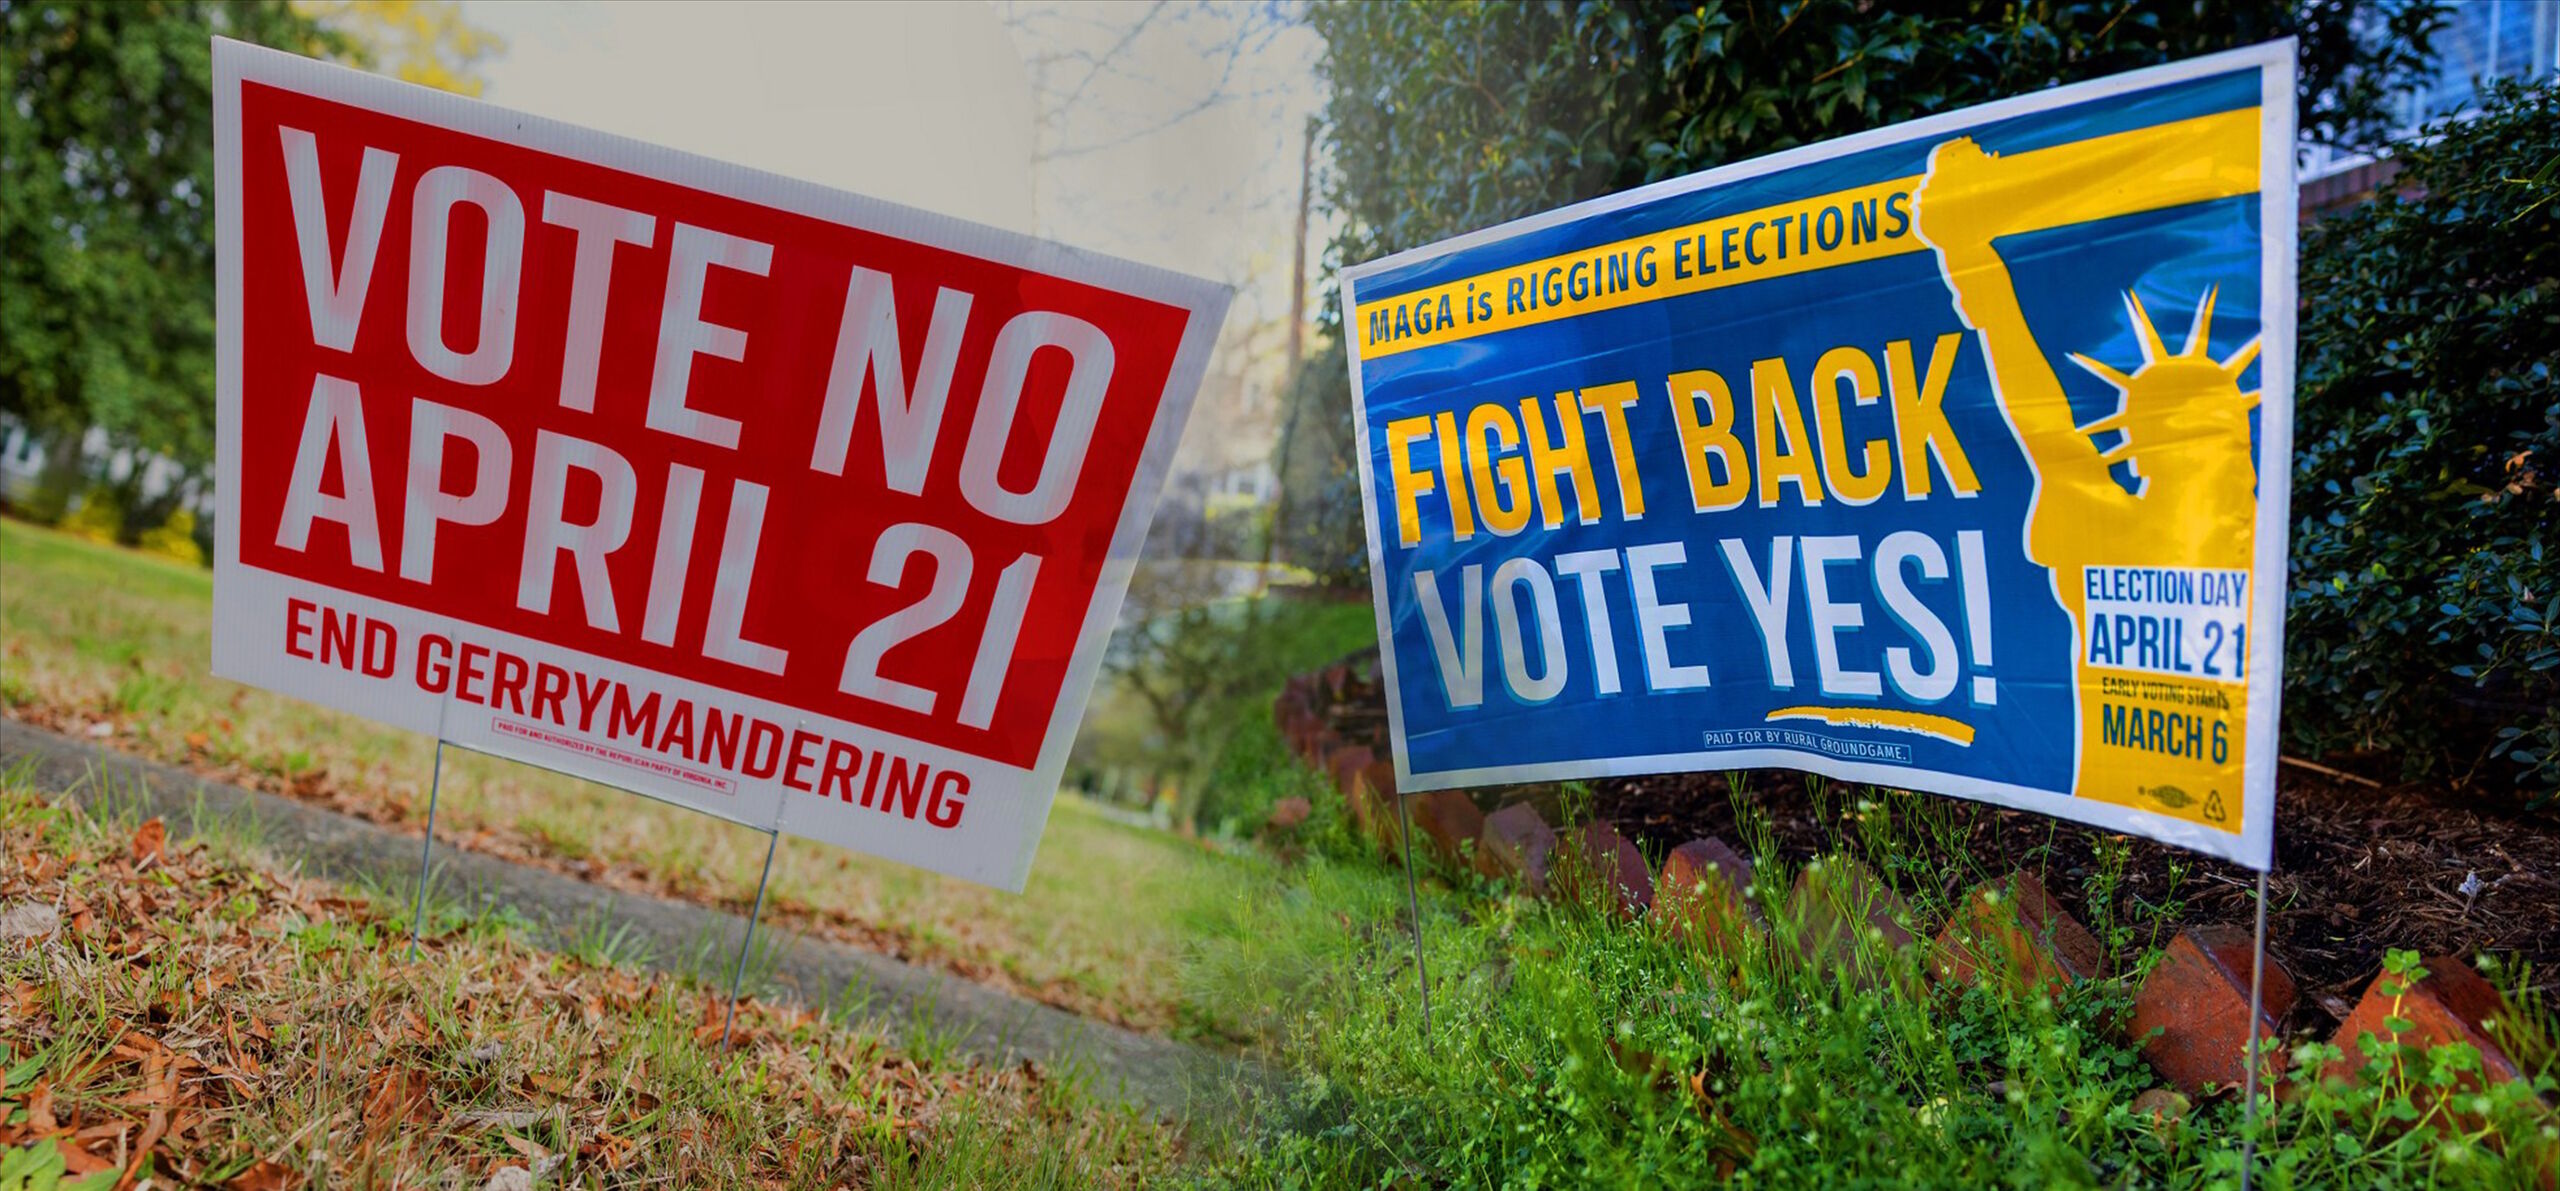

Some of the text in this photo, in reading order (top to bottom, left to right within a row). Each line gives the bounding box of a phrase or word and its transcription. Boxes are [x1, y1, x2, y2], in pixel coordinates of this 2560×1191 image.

[1368, 191, 1909, 346] MAGA is RIGGING ELECTIONS
[278, 124, 1115, 525] VOTE NO
[1386, 332, 1983, 549] FIGHT BACK
[274, 372, 1043, 731] APRIL 21
[2085, 568, 2247, 607] ELECTION DAY
[1411, 530, 1997, 712] VOTE YES!
[2089, 613, 2246, 678] APRIL 21
[285, 597, 971, 829] END GERRYMANDERING
[1705, 731, 1907, 761] PAID FOR BY RURAL GROUNDGAME.
[2102, 677, 2140, 697] EARLY
[2141, 681, 2185, 705] VOTING
[2102, 703, 2228, 765] MARCH 6
[498, 722, 514, 732] PAID
[515, 726, 528, 736] FOR
[529, 730, 543, 740] AND
[544, 734, 584, 751] AUTHORIZED
[585, 745, 594, 753] BY
[595, 747, 607, 757] THE
[609, 751, 650, 768] REPUBLICAN
[651, 762, 672, 774] PARTY
[672, 768, 681, 777] OF
